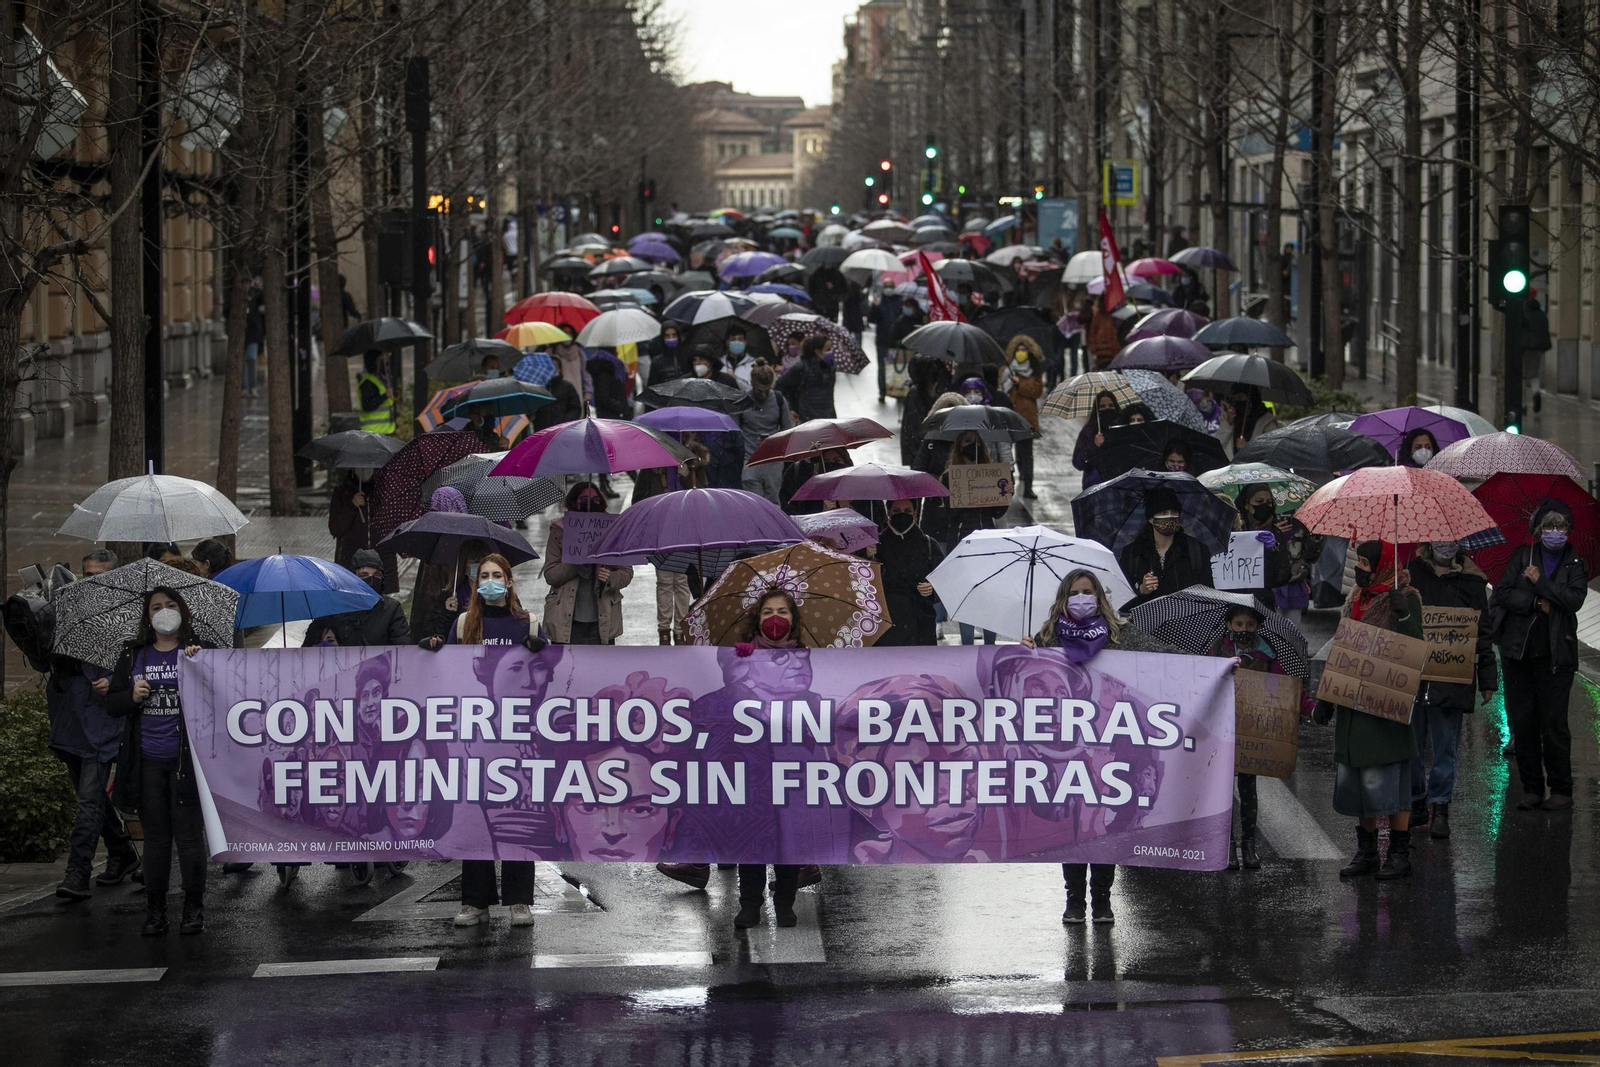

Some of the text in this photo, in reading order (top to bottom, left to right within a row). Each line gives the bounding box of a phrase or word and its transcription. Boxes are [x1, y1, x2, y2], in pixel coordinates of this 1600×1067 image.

[951, 469, 962, 480] LO
[952, 480, 963, 490] AL
[952, 498, 964, 507] LA
[568, 517, 585, 529] UN
[568, 544, 582, 557] UN
[1423, 611, 1479, 625] OFEMINISMO
[1385, 667, 1409, 690] NO
[226, 696, 1196, 751] CON DERECHOS, SIN BARRERAS.
[273, 757, 1150, 808] FEMINISTAS SIN FRONTERAS.
[277, 842, 298, 852] 25N
[300, 842, 308, 851] Y
[309, 842, 326, 851] 8M
[335, 841, 392, 851] FEMINISMO
[394, 839, 435, 850] UNITARIO
[1133, 845, 1206, 861] GRANADA 2021
